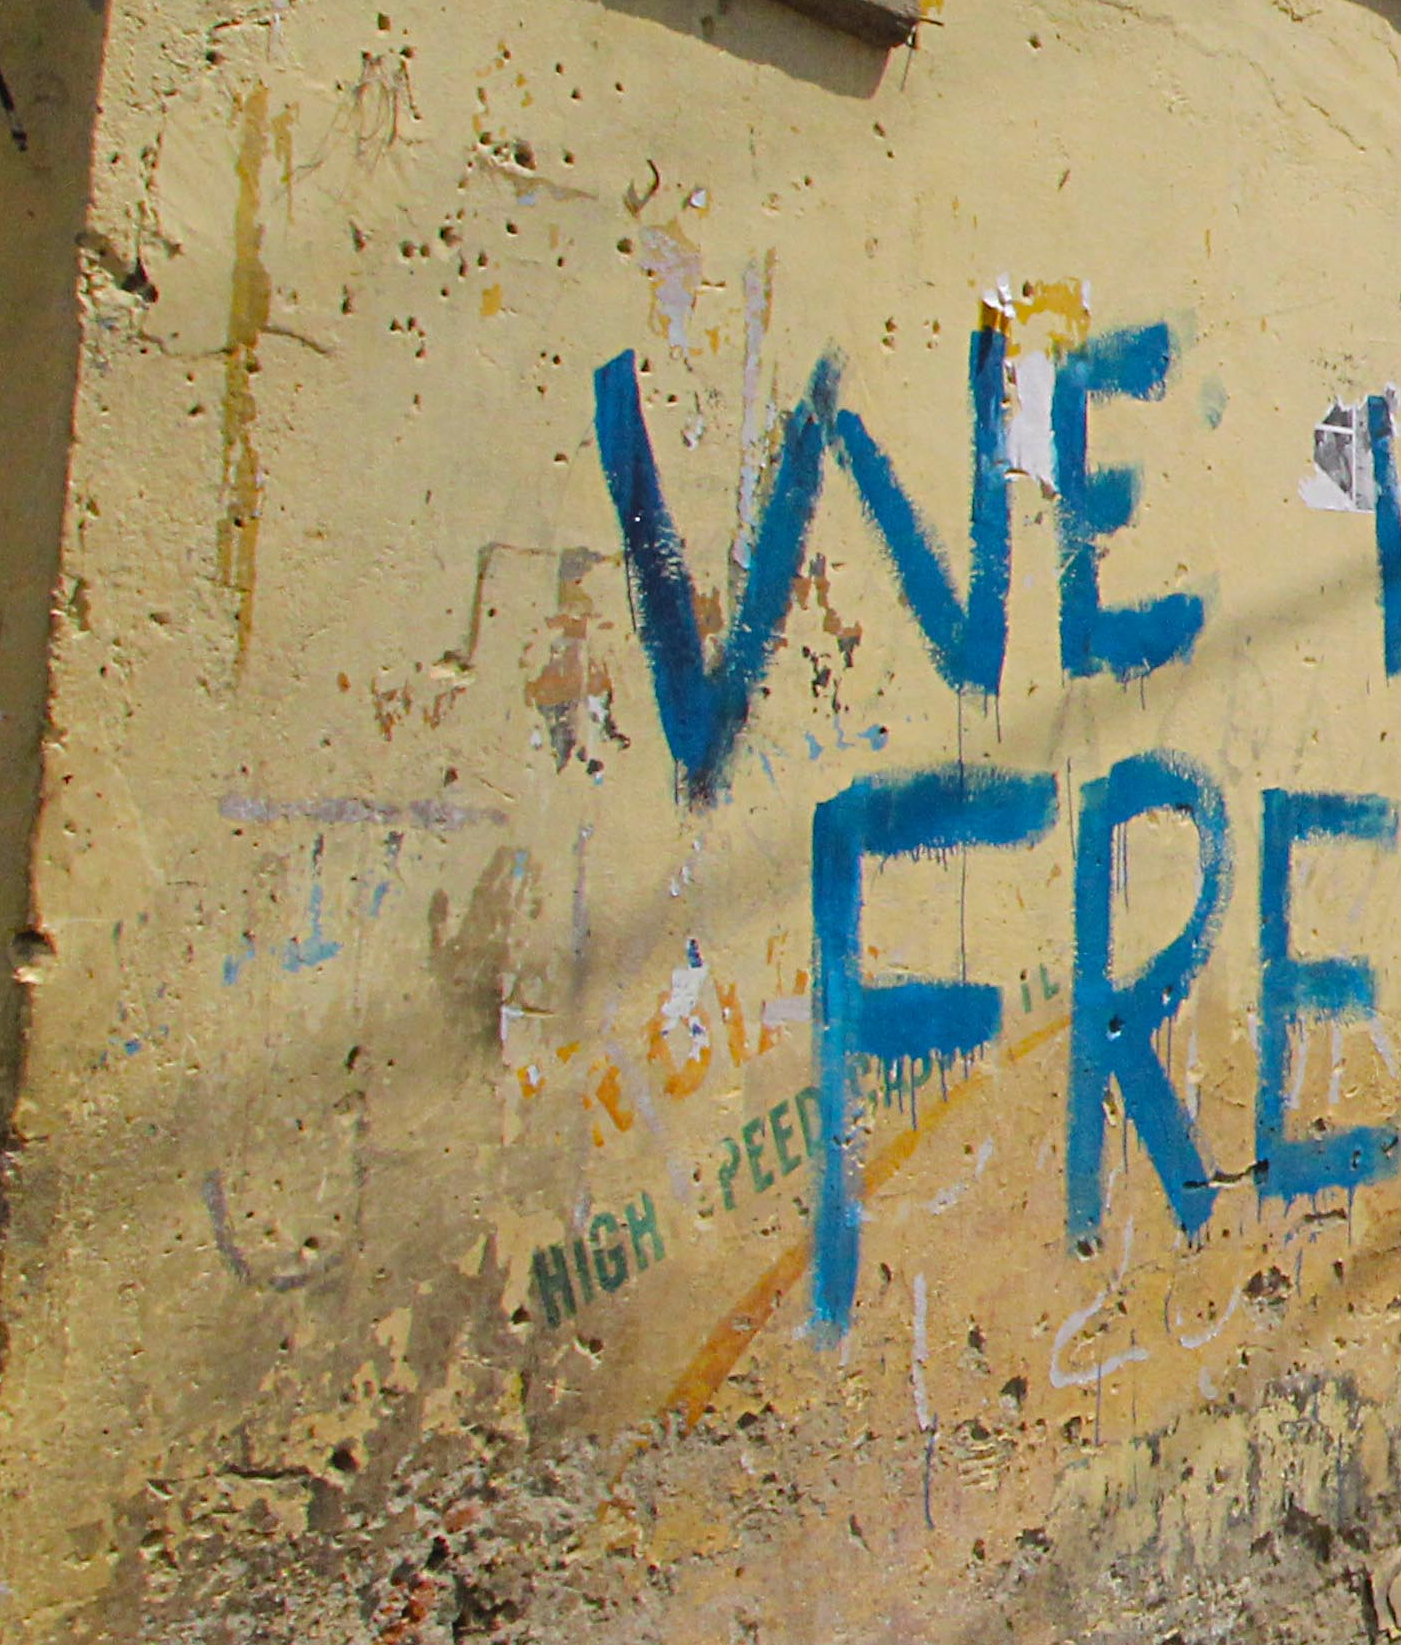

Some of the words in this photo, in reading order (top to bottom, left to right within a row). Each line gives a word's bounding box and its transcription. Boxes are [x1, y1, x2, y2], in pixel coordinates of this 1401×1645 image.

[593, 322, 1205, 805] WE
[532, 1192, 665, 1329] HIGH
[698, 1085, 828, 1214] PEED
